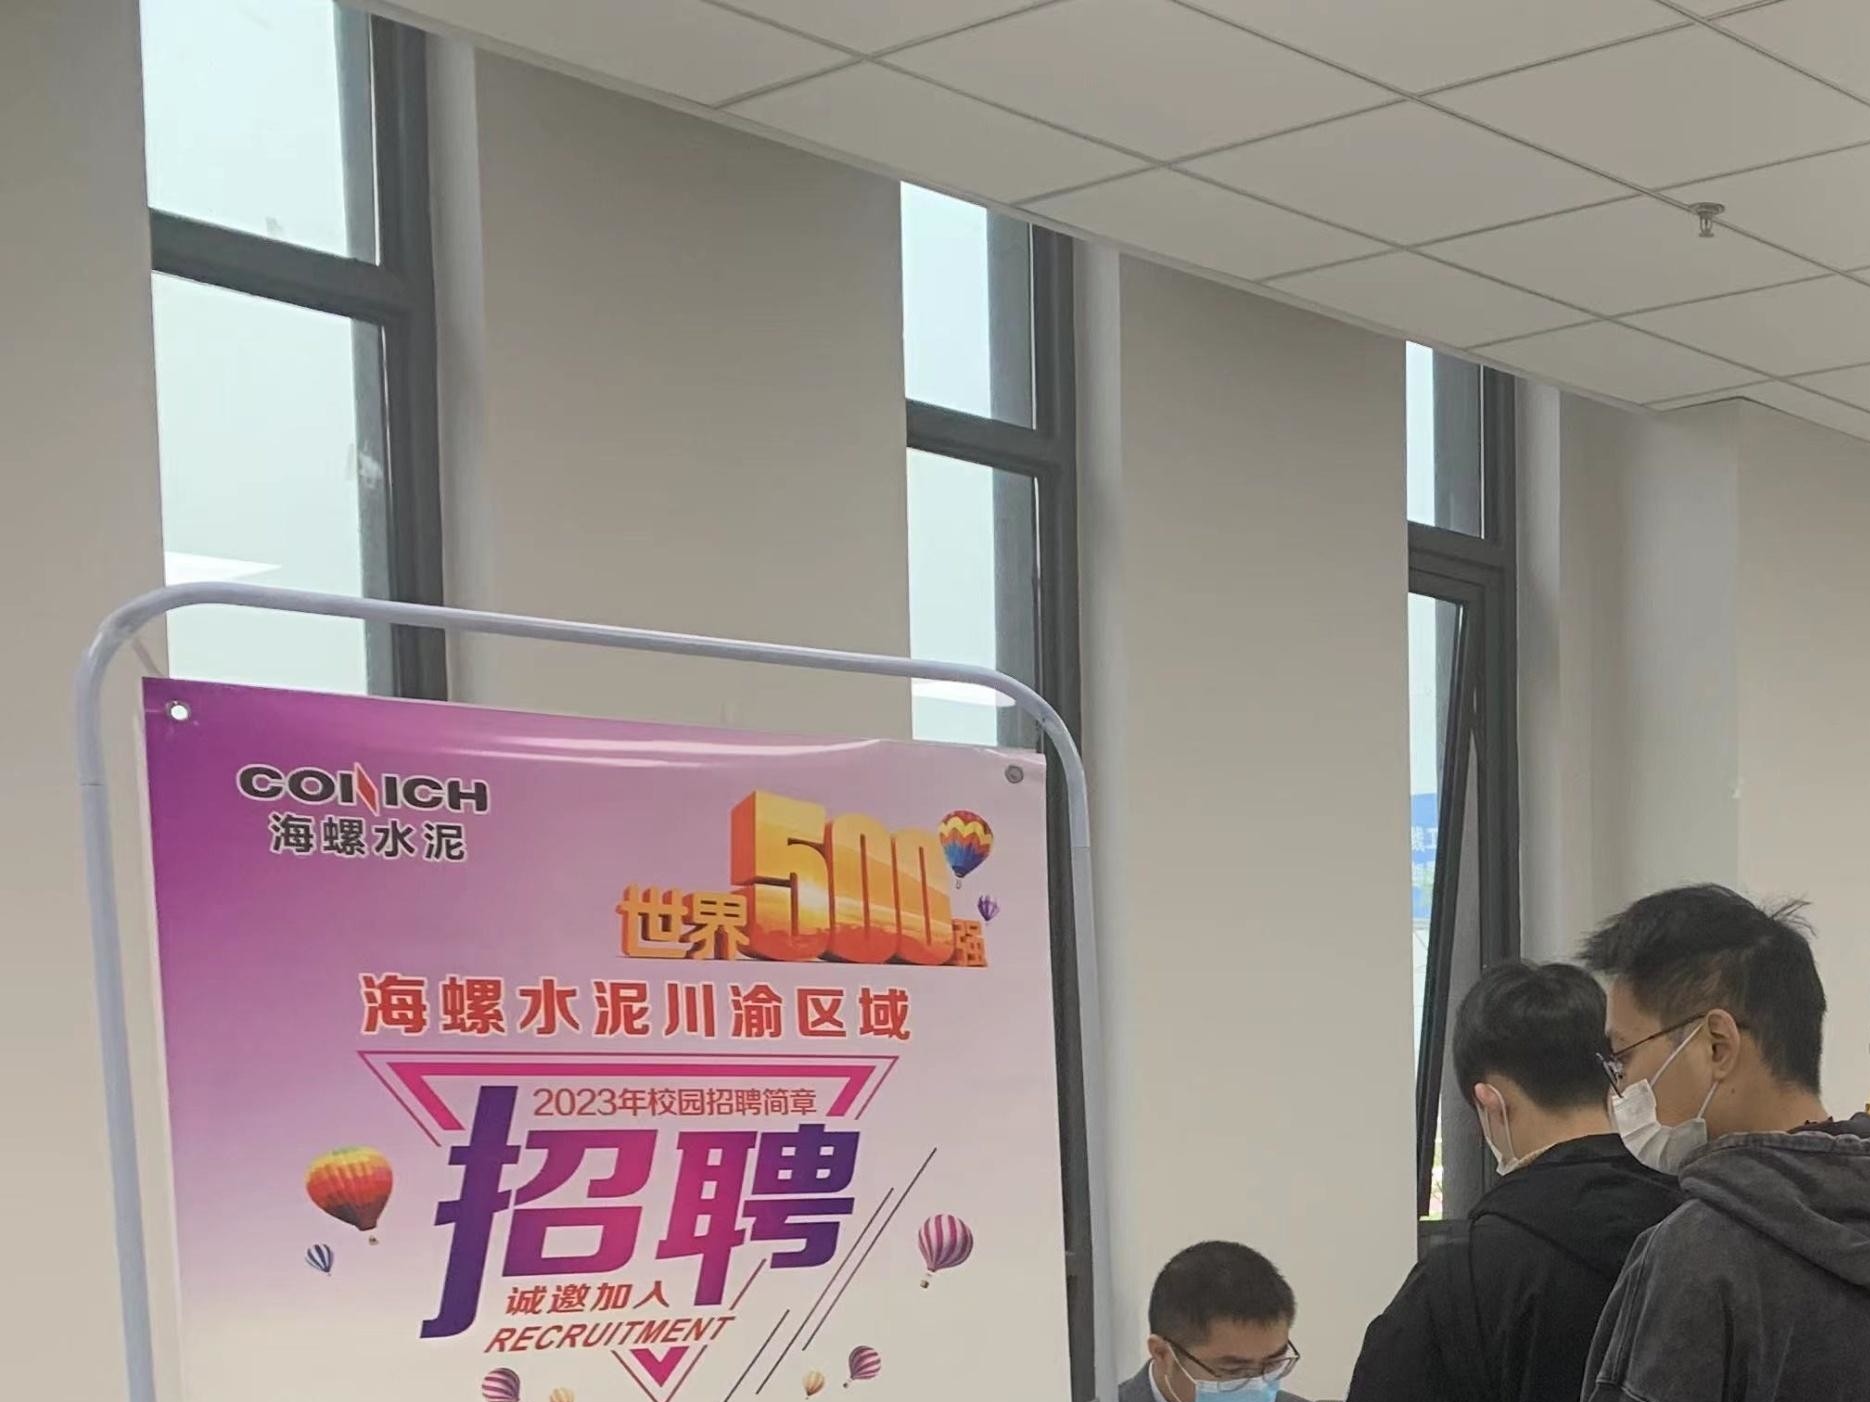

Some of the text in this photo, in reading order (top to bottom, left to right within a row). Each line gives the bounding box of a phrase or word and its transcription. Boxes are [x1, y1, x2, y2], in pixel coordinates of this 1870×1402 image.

[270, 813, 465, 860] 海螺水泥
[616, 790, 987, 967] 世界500强
[362, 974, 911, 1040] 海螺水泥川渝区域
[533, 1087, 817, 1117] 2023年校园招聘简章
[420, 1085, 860, 1338] 招聘
[506, 1280, 668, 1316] 诚邀加入
[484, 1317, 735, 1353] RECRUITMENT
